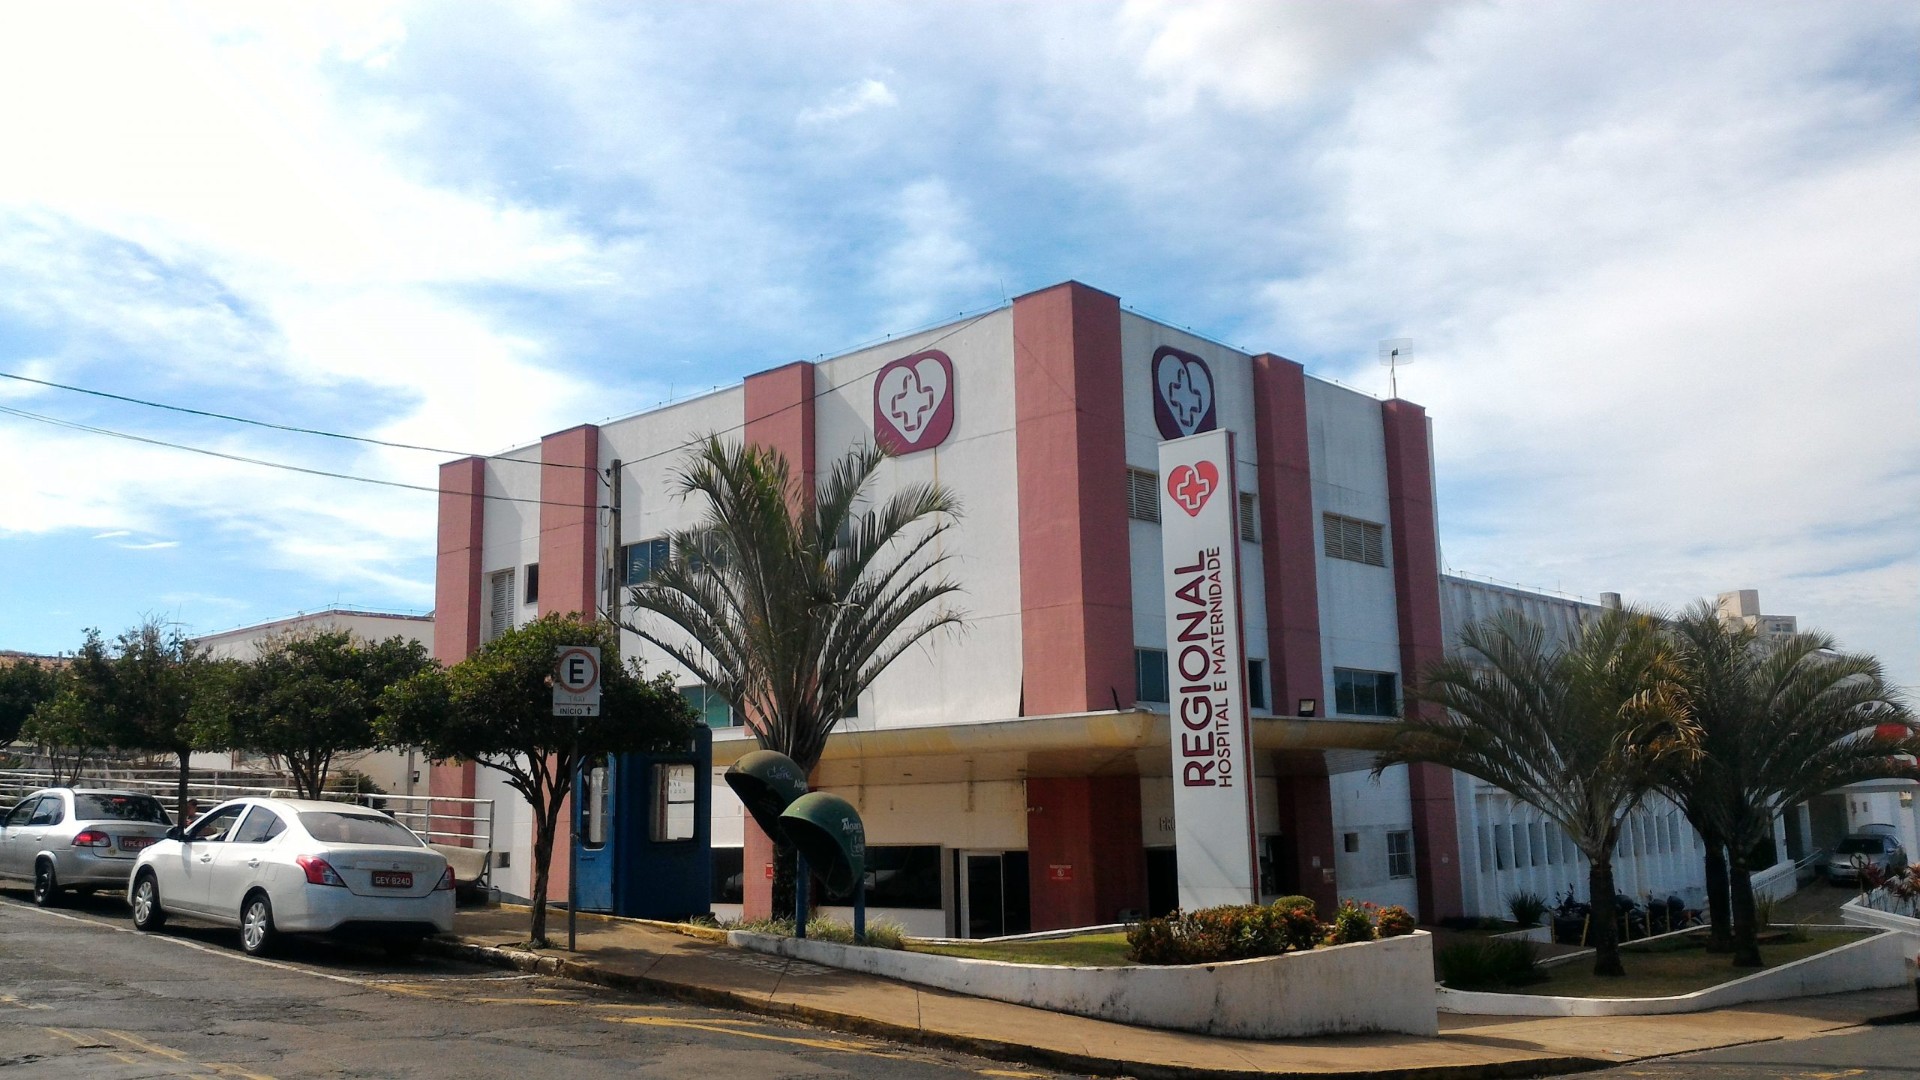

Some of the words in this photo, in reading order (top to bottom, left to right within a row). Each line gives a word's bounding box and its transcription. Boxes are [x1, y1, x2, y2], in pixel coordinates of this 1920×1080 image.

[1207, 546, 1227, 675] MATERNIDADE
[569, 658, 584, 684] E
[1174, 550, 1216, 787] REGIONAL
[1214, 681, 1228, 692] E
[1216, 698, 1232, 788] HOSPITAL
